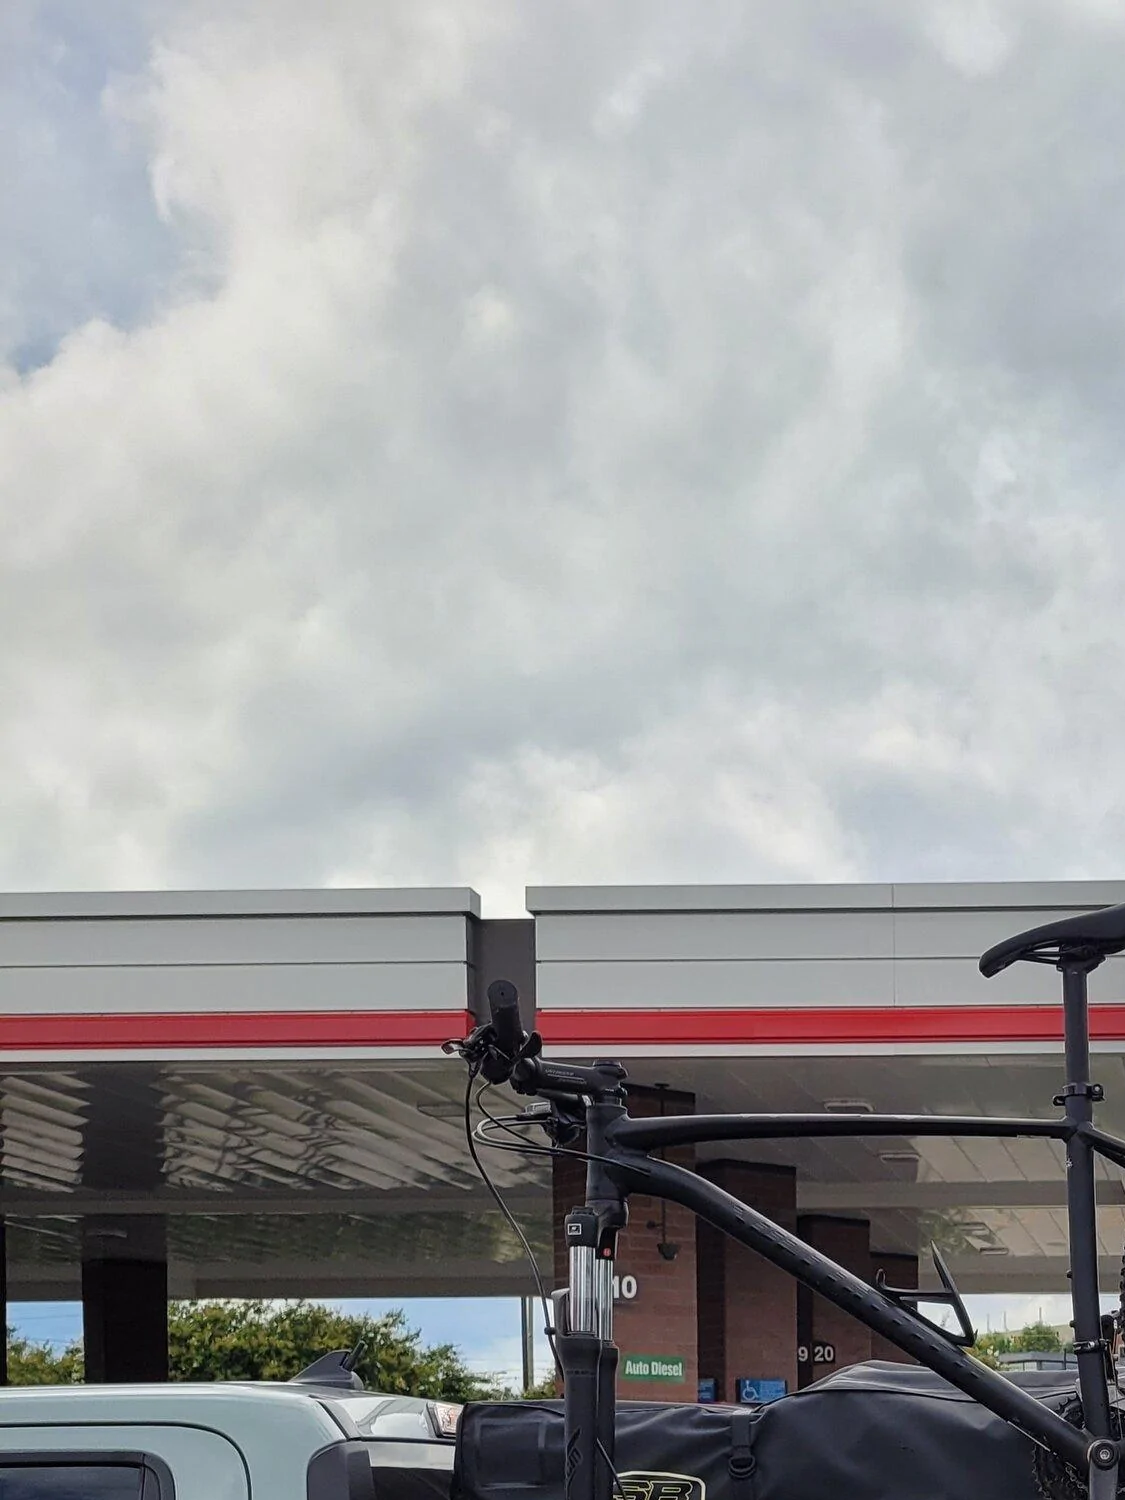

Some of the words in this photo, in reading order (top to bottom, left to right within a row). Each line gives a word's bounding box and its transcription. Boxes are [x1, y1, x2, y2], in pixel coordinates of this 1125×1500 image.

[612, 1275, 638, 1299] 10
[814, 1346, 834, 1362] 20
[625, 1360, 649, 1375] Auto
[651, 1361, 683, 1376] Diesel
